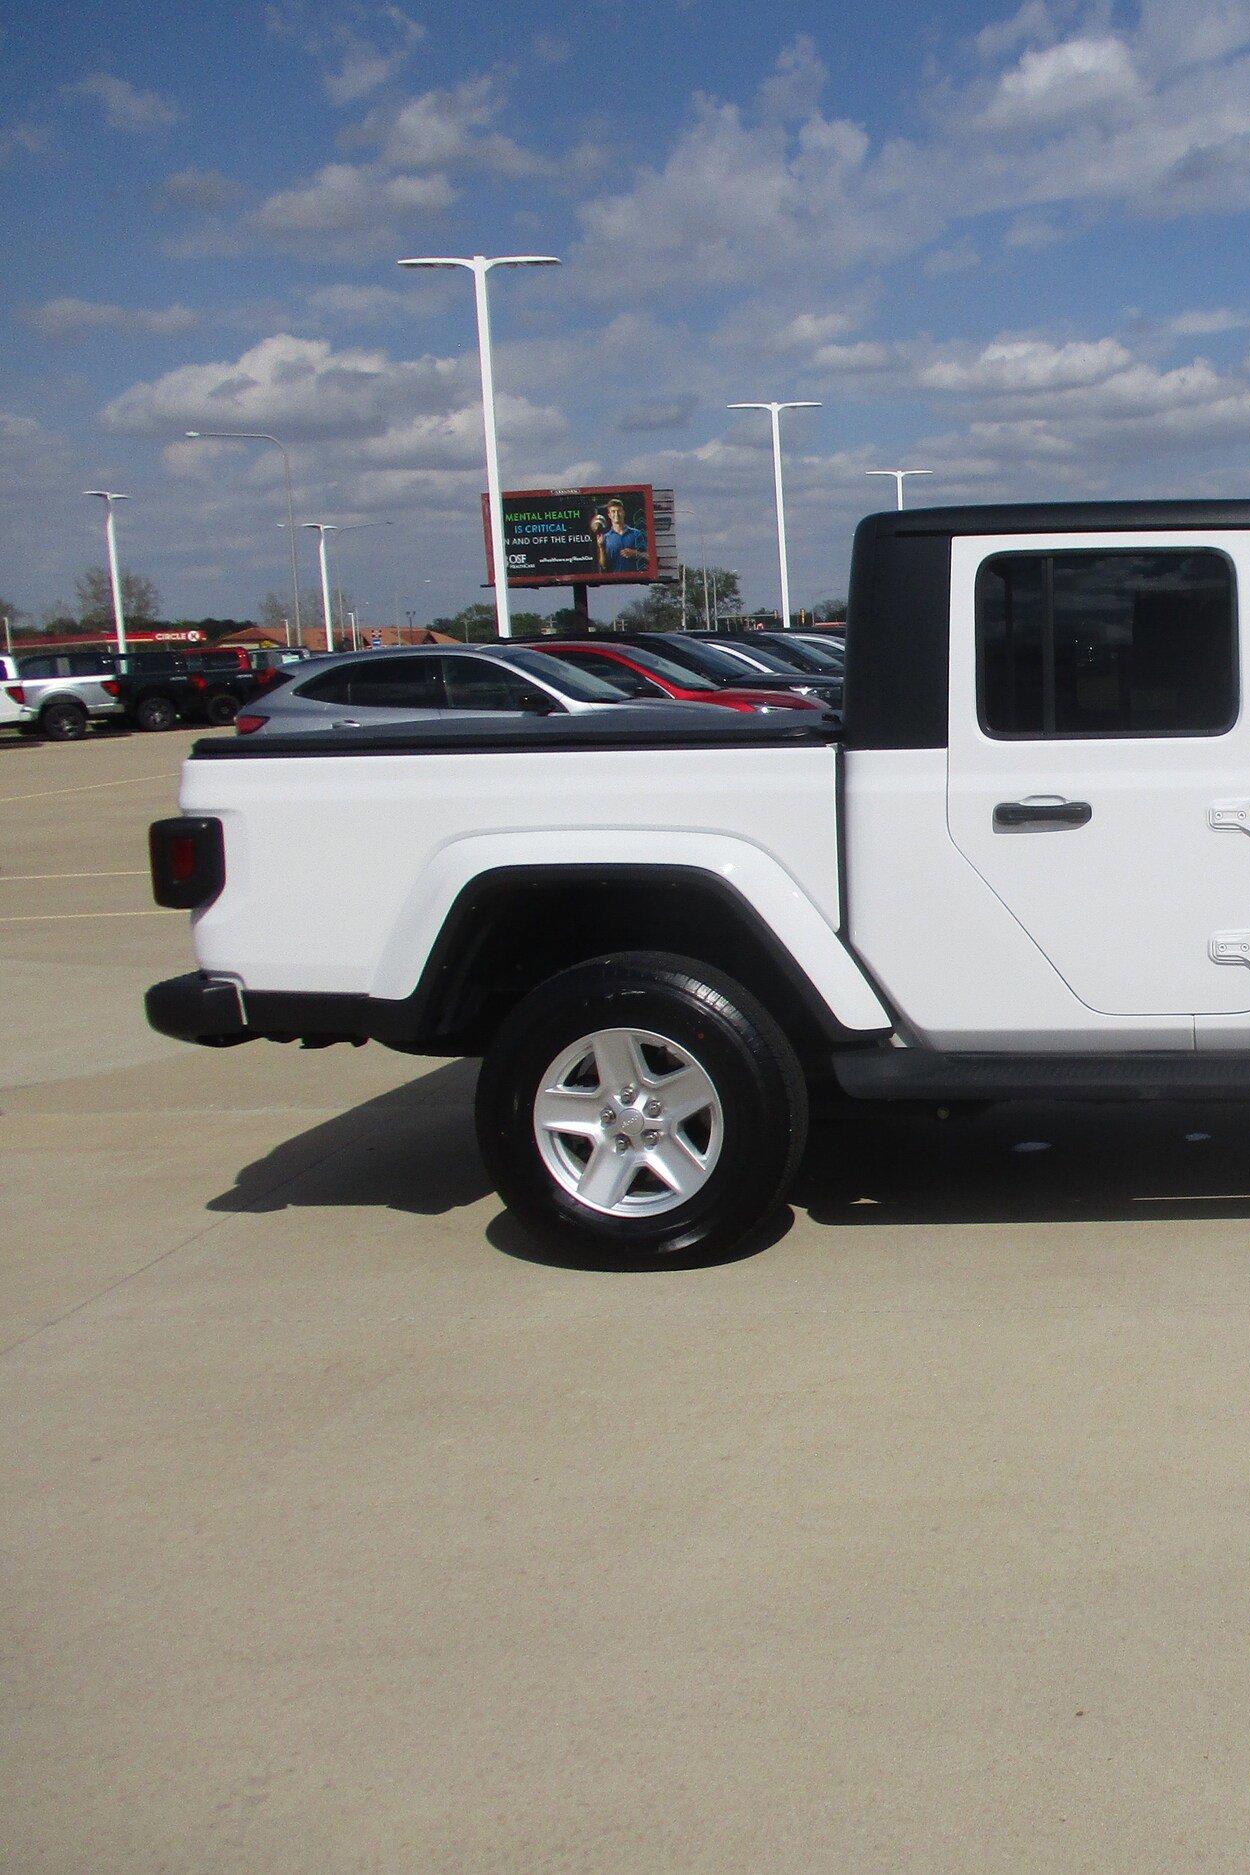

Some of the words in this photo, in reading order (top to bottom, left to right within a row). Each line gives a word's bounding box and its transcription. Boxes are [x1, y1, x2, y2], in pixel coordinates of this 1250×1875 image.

[505, 512, 542, 521] MENTAL
[544, 510, 580, 520] HEALTH
[514, 525, 523, 534] IS
[525, 523, 567, 533] CRITICAL
[511, 537, 530, 545] AND
[532, 536, 549, 545] OFF
[551, 535, 566, 544] THE
[568, 534, 593, 543] FIELD.
[508, 554, 526, 563] OSF
